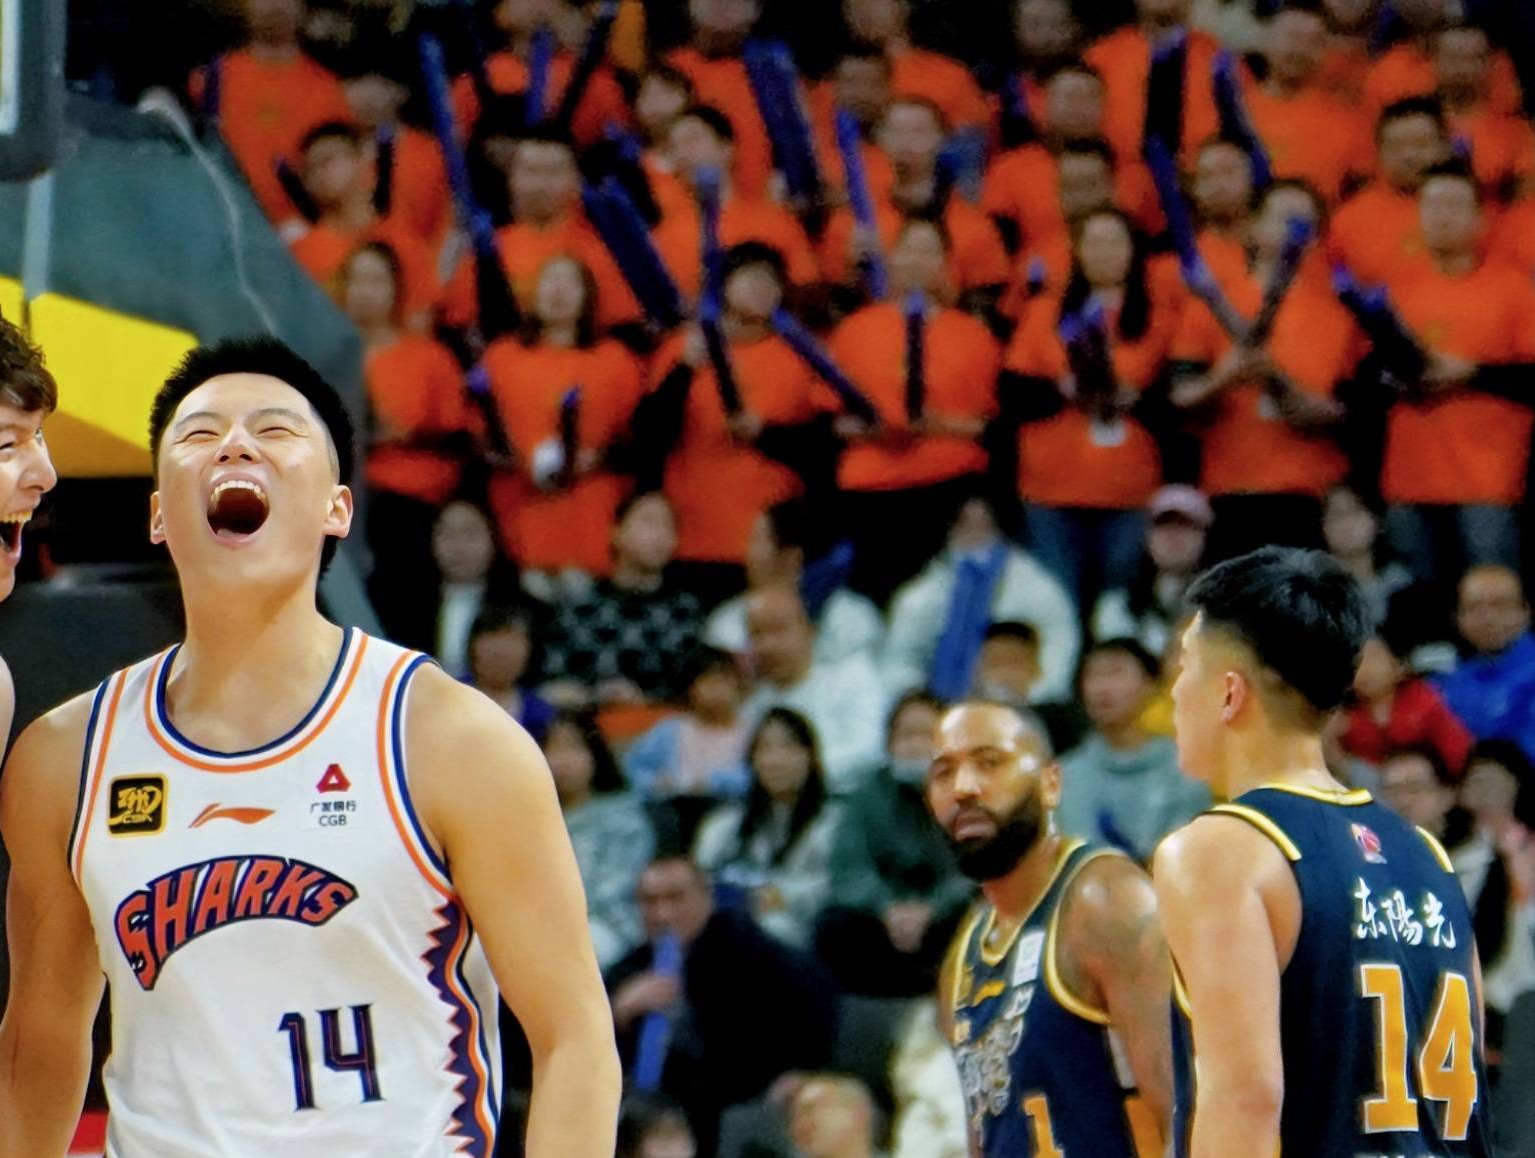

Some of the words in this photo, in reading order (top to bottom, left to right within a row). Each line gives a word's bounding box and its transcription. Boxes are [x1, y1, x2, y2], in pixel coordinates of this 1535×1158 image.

[319, 814, 347, 827] CGB
[114, 855, 359, 991] SHARKS
[277, 1003, 387, 1112] 14
[1360, 963, 1478, 1141] 14
